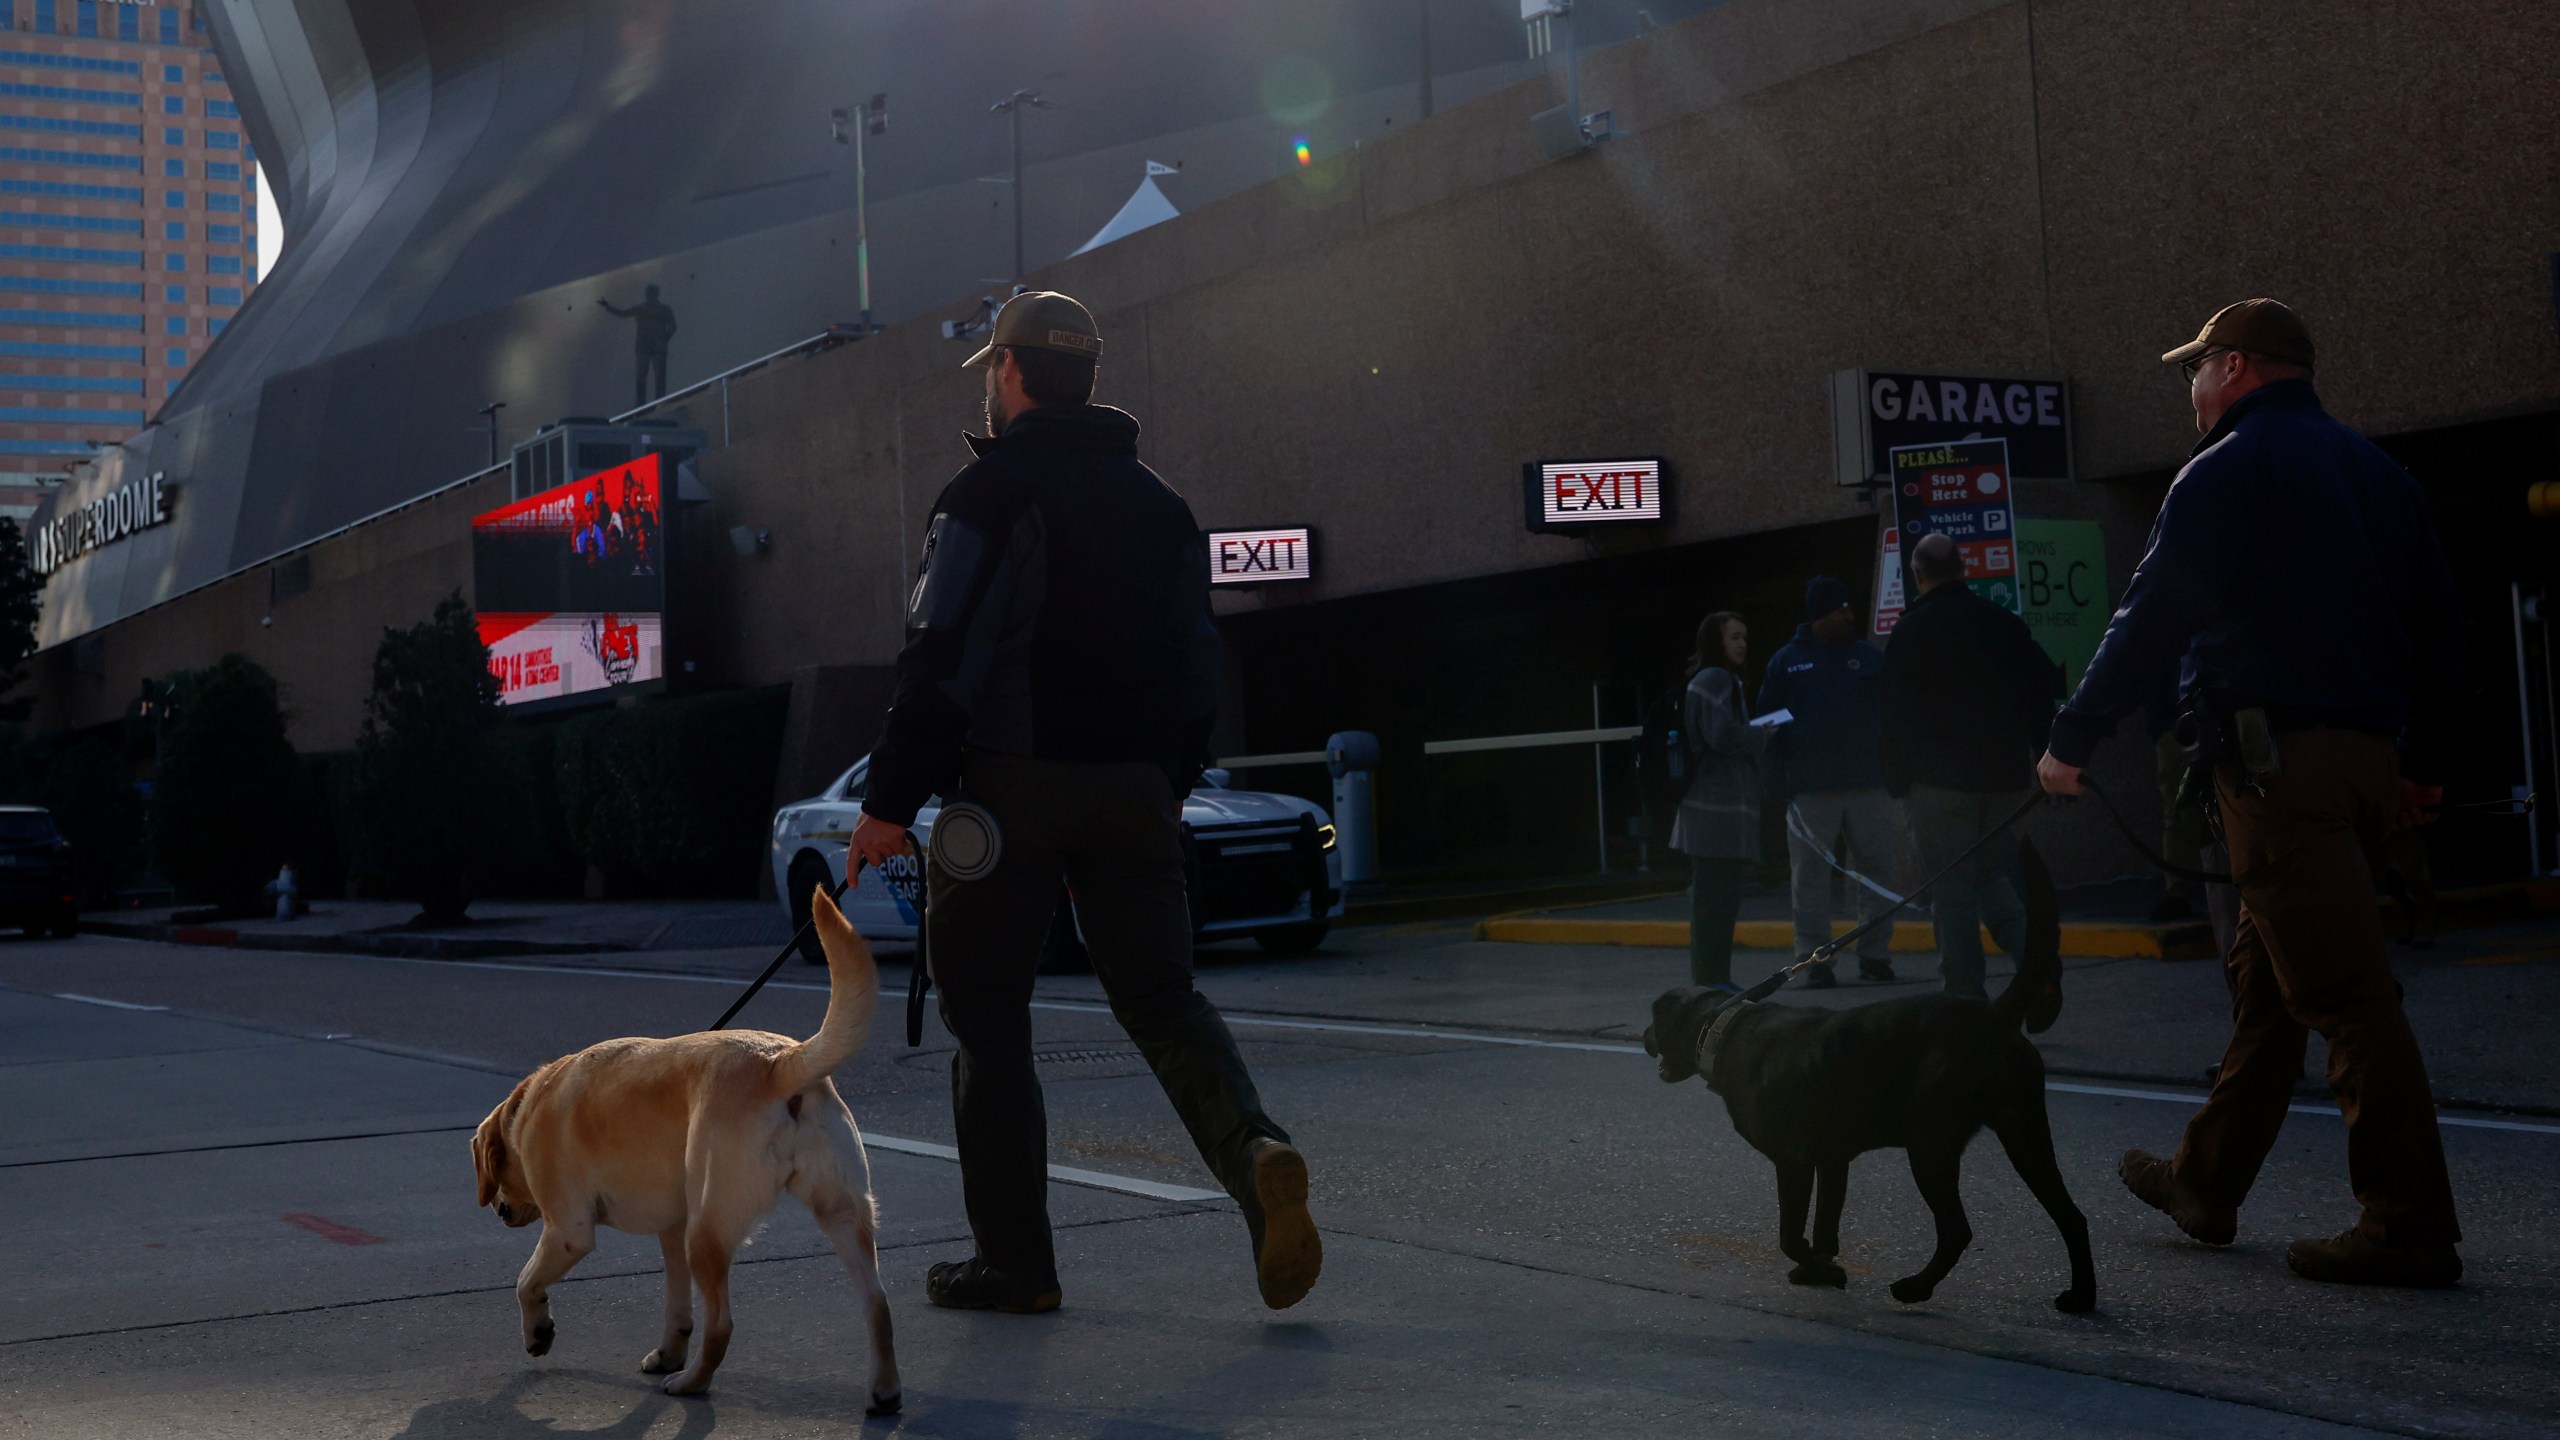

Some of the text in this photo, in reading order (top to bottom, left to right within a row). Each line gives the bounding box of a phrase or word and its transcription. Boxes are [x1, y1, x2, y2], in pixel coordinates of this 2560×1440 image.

[1871, 377, 2061, 427] GARAGE
[1555, 471, 1650, 511] EXIT
[1931, 474, 1966, 487] Stop
[1931, 489, 1968, 501] Here
[57, 471, 166, 564] SUPERDOME
[1930, 512, 1974, 524] Vehicle
[1946, 524, 1976, 536] Park
[1220, 538, 1301, 573] EXIT
[2046, 612, 2080, 627] HERE
[510, 653, 521, 691] 14
